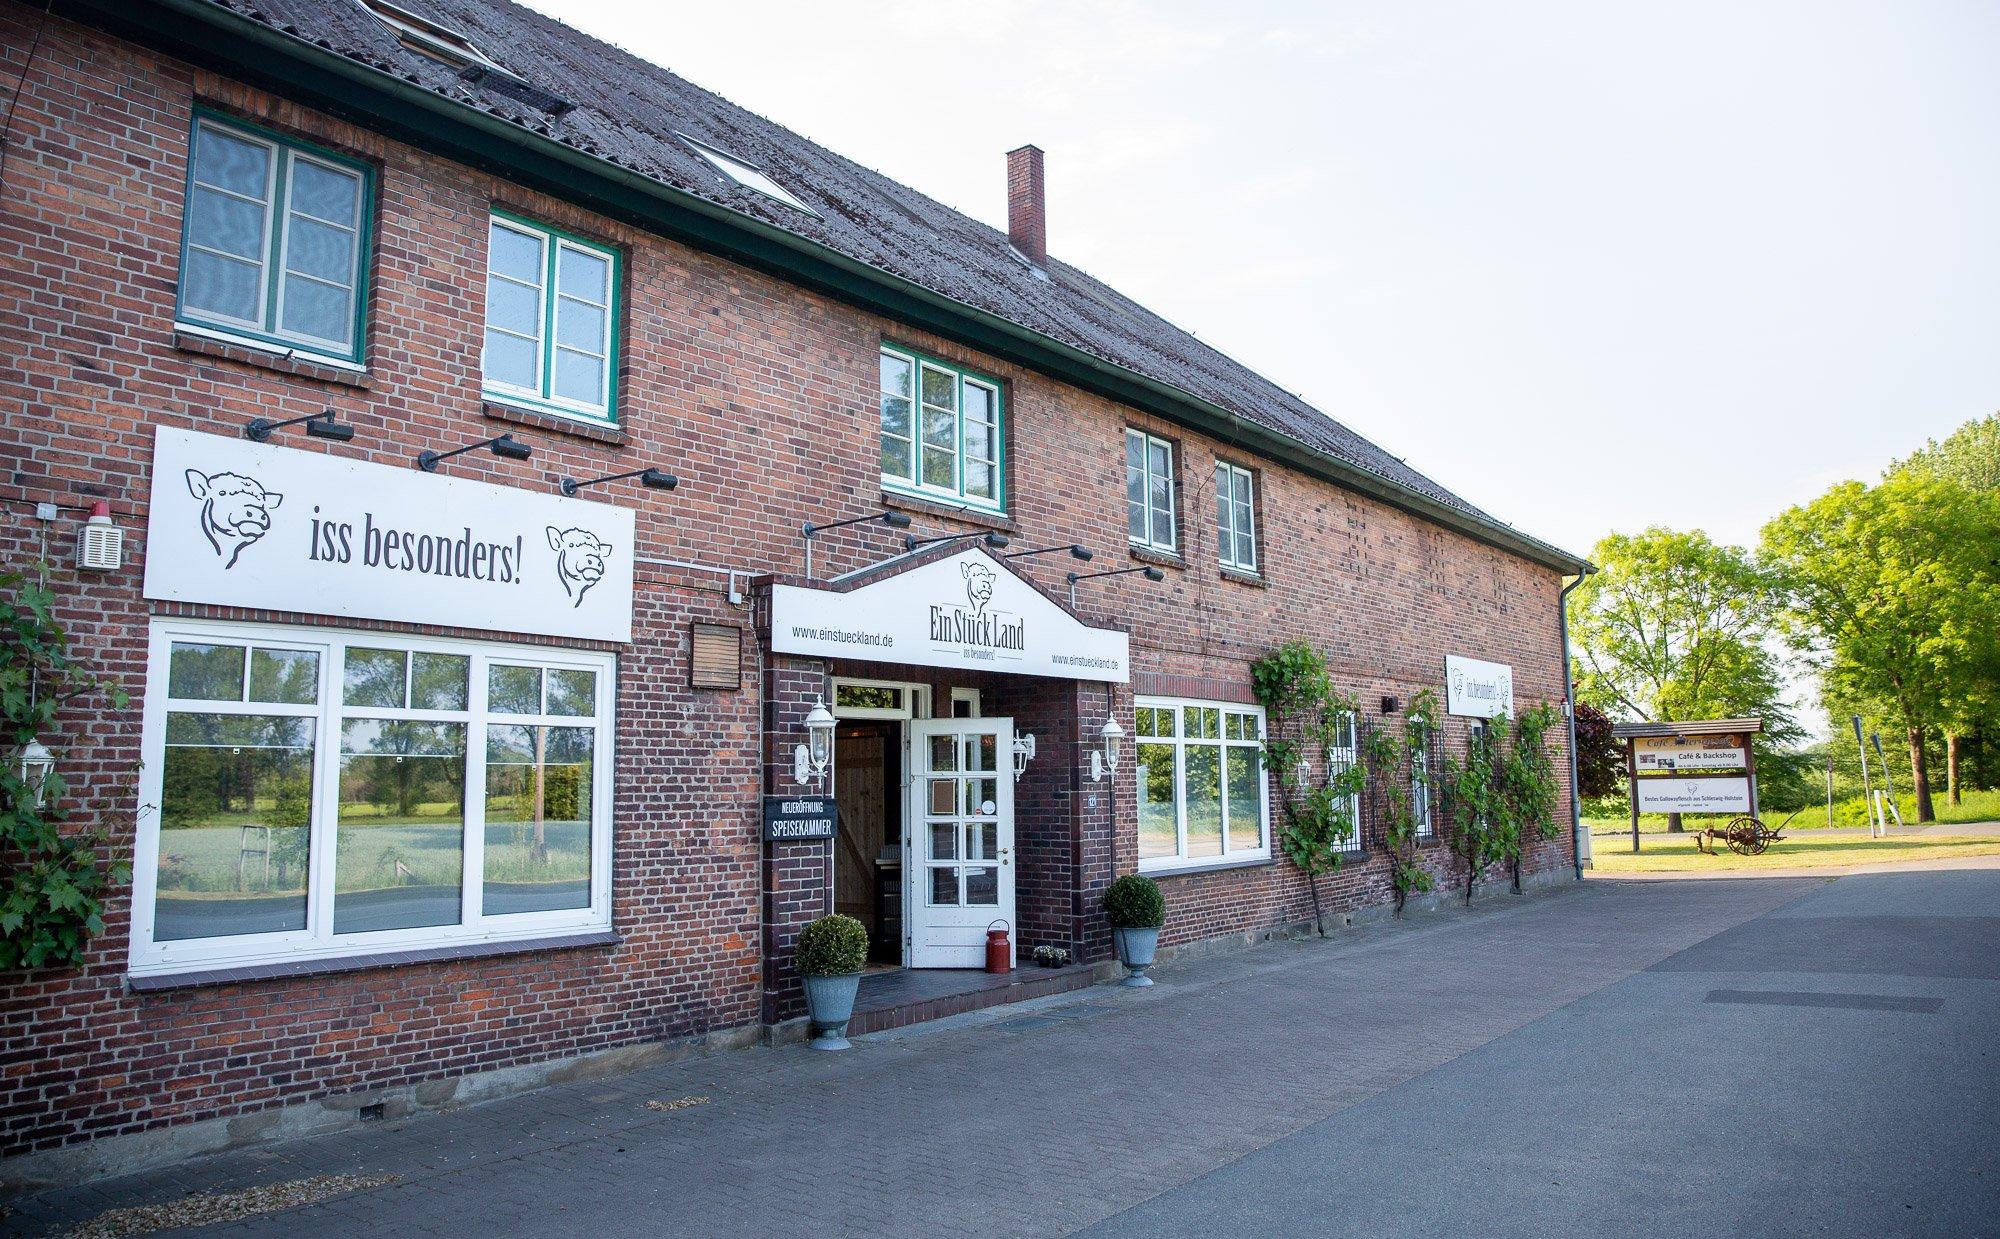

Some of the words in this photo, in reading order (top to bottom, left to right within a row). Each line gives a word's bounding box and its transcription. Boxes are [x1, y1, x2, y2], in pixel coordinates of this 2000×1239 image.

[308, 505, 352, 564] iss
[363, 512, 523, 585] besonders!
[791, 626, 893, 648] www.einstueckland.de
[1051, 654, 1119, 670] www.einstueckland.de
[1678, 752, 1694, 760] Café
[1703, 752, 1737, 760] Backshop
[781, 800, 824, 814] NEUERÖFFNUNG
[772, 819, 832, 837] SPEISEKAMMER
